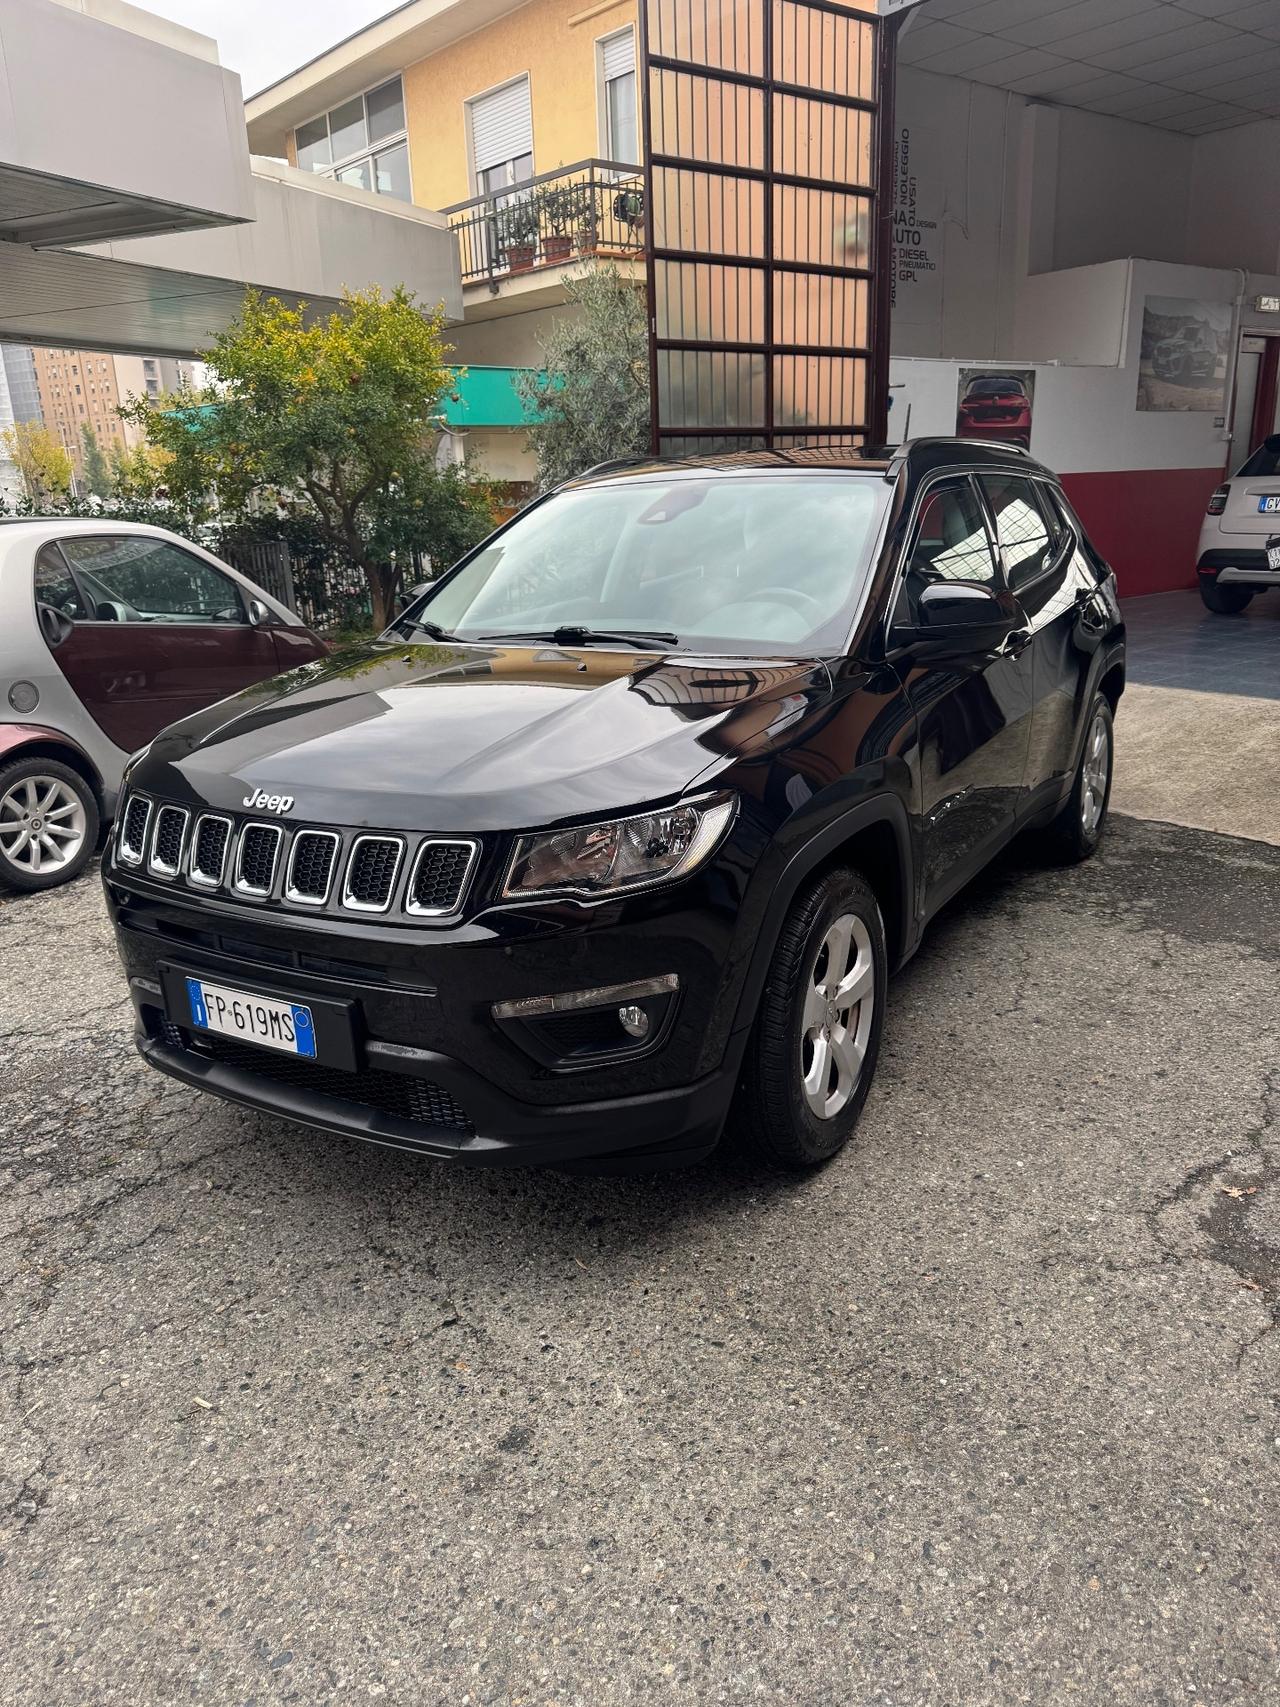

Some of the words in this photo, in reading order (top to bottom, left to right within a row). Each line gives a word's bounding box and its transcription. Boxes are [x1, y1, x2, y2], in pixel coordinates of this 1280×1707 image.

[900, 128, 909, 205] NOLEGGIO
[908, 176, 917, 227] USATO
[916, 220, 937, 229] DESIGN
[893, 228, 921, 246] UTO
[899, 248, 929, 261] DIESEL
[899, 260, 936, 271] PNEUMATICI
[899, 270, 917, 282] GPL
[242, 788, 294, 815] Jeep
